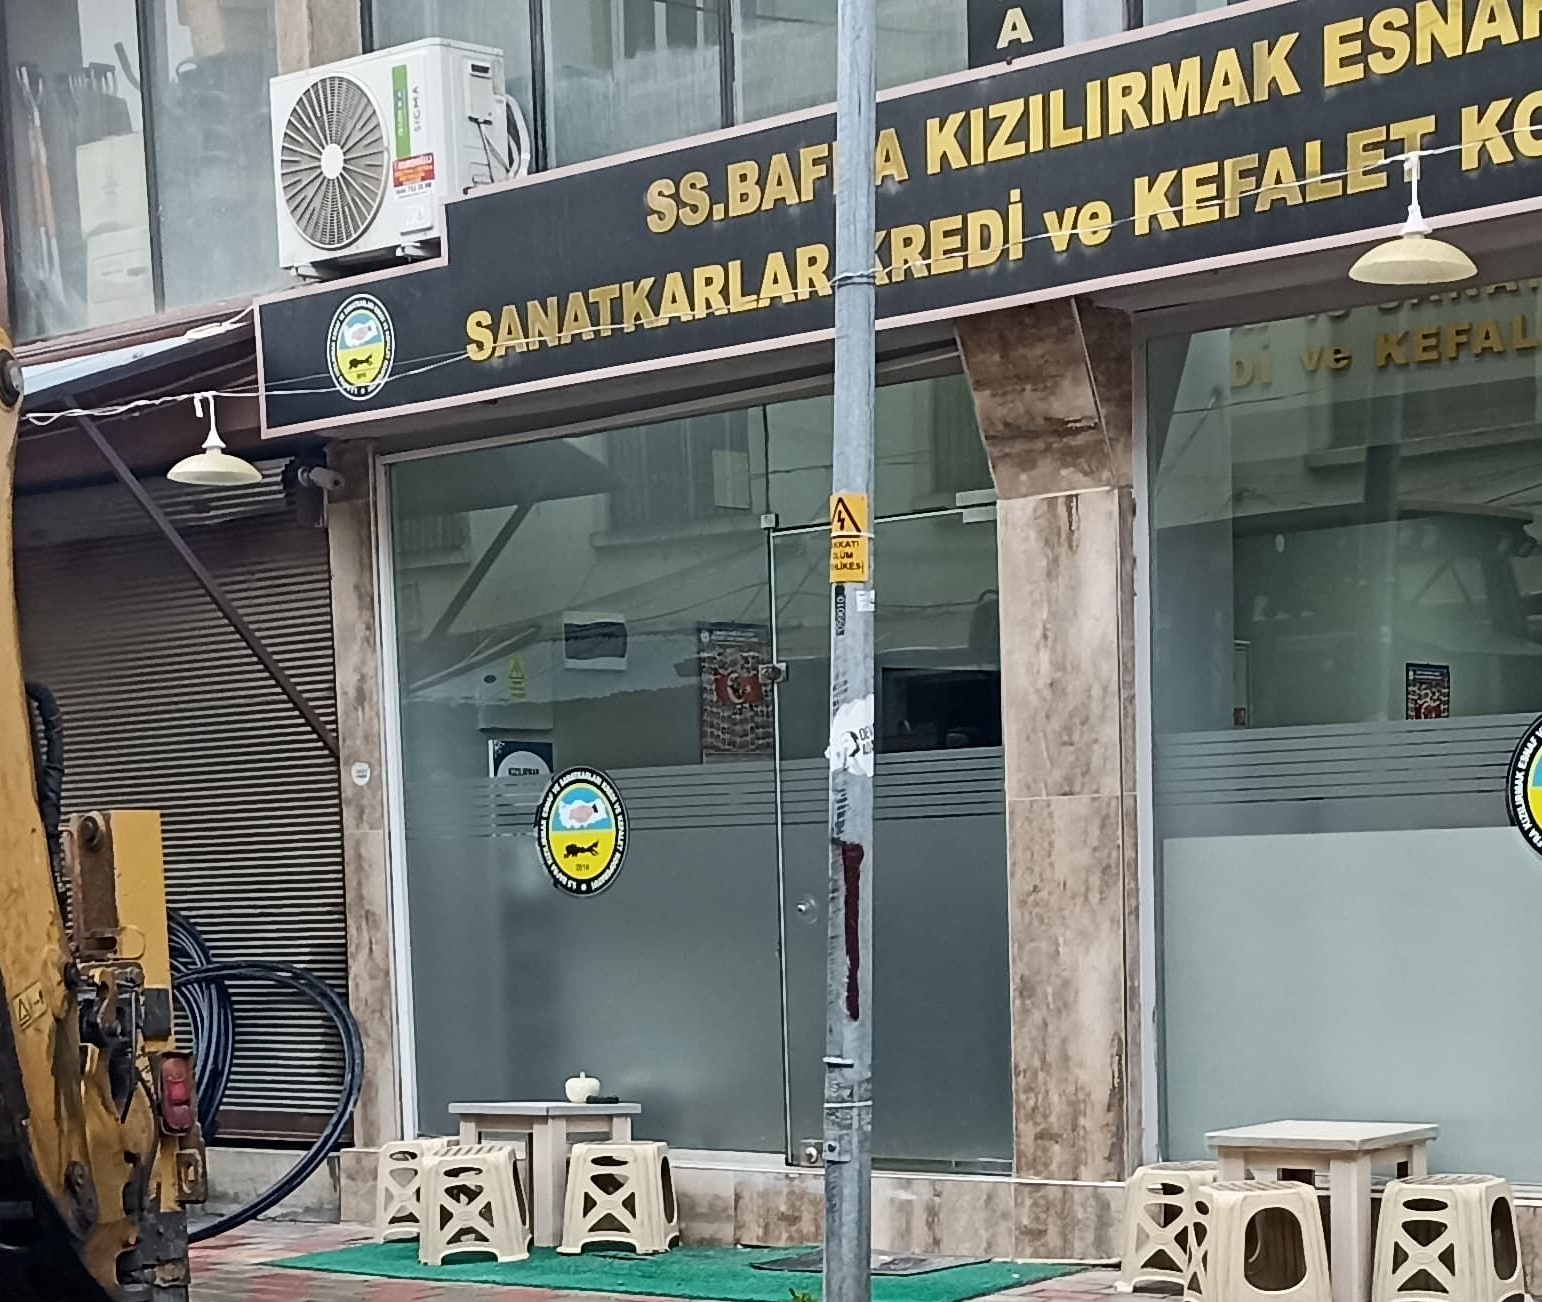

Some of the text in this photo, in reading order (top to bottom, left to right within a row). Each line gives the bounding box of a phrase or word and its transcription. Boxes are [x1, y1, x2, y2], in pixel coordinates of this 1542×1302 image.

[996, 7, 1034, 50] A
[646, 127, 909, 234] SS.BAFA
[926, 32, 1302, 176] KIZILIRMAK
[464, 243, 833, 362] SANATKARLAR
[1044, 200, 1112, 253] ve
[1133, 114, 1436, 237] KEFALET
[1300, 344, 1353, 371] ve
